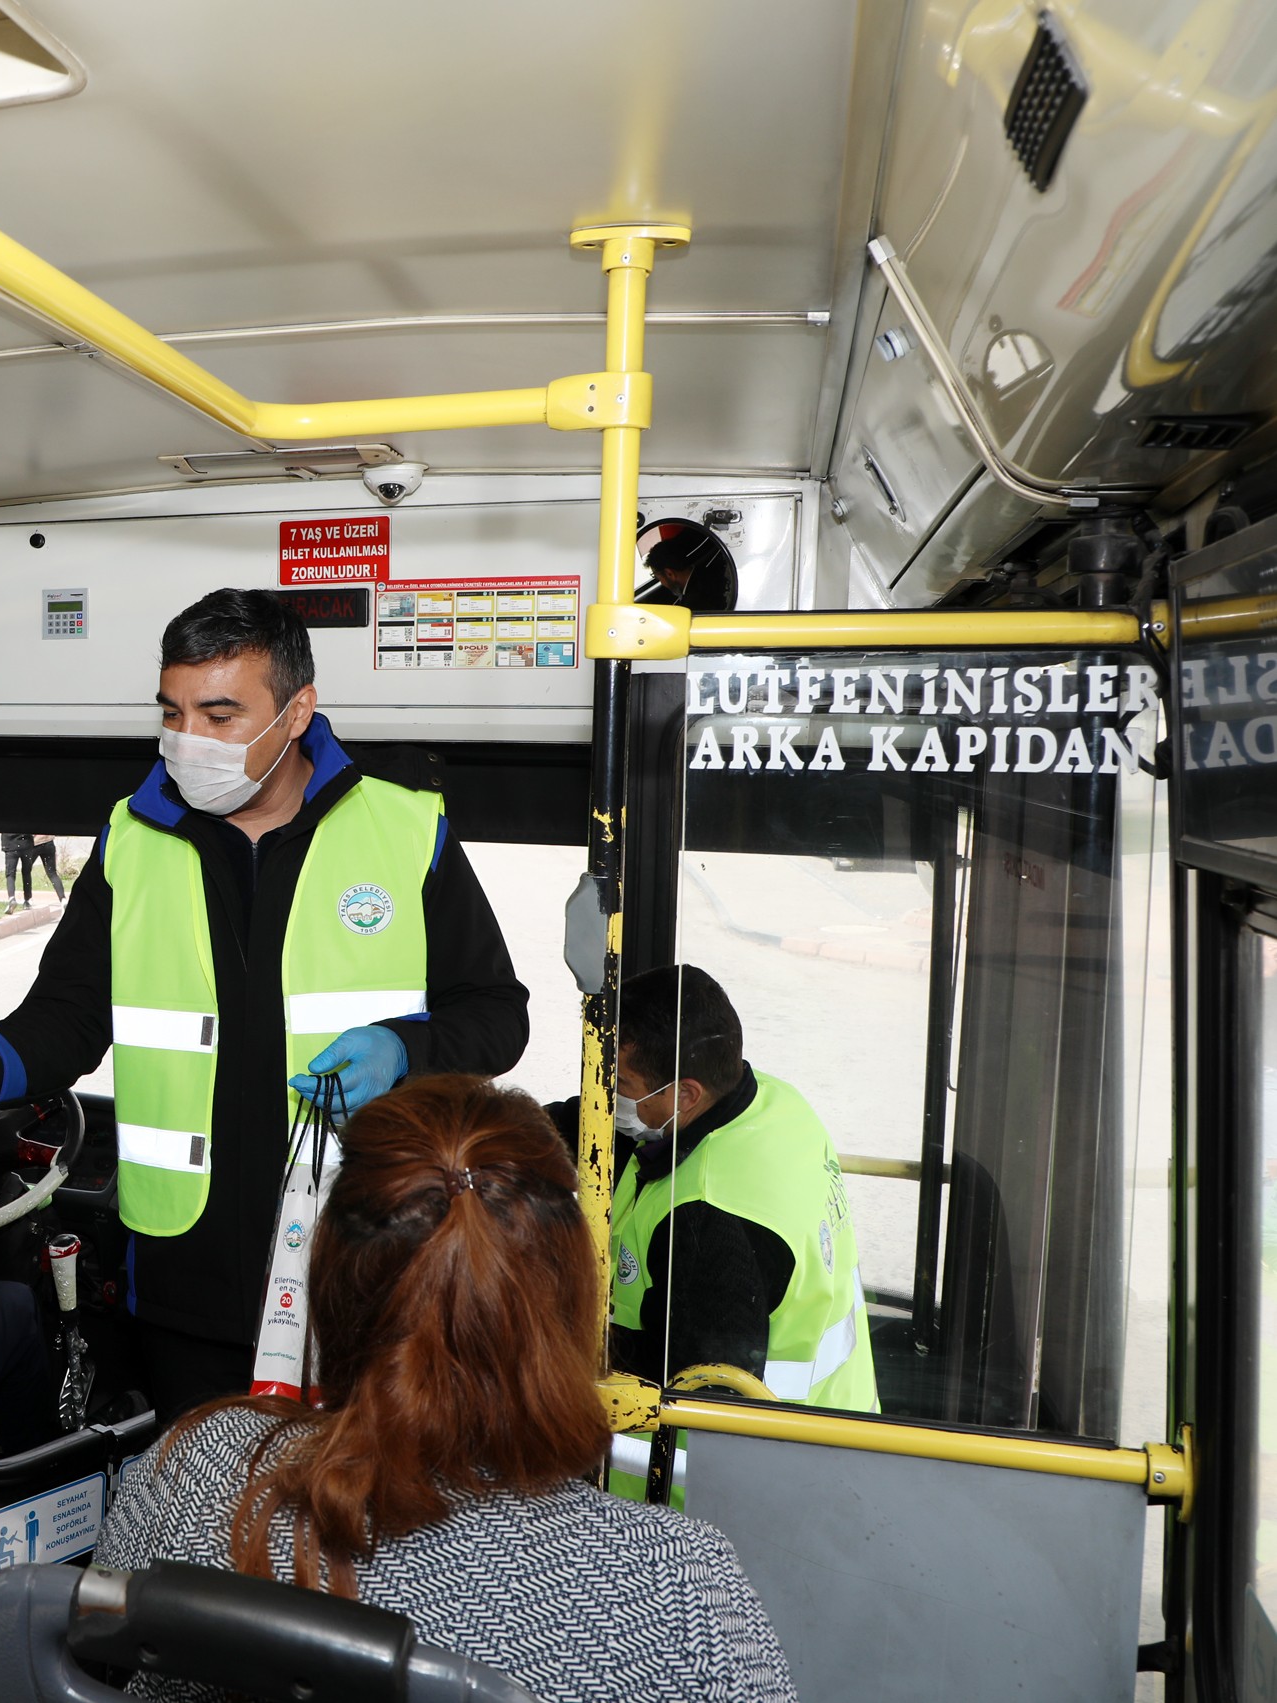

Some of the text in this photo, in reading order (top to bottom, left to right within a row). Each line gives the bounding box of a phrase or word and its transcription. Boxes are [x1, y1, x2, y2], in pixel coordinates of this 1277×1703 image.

[290, 521, 378, 543] 7 YAŞ VE ÜZERİ
[282, 544, 387, 560] BİLET KULLANILMASI
[291, 564, 371, 580] ZORUNLUDUR
[689, 725, 846, 770] ARKA
[866, 726, 1144, 774] KAPIDAN
[340, 886, 392, 917] TALAS BELEDİYESİ
[274, 1276, 304, 1288] Ellerimizi
[289, 1286, 297, 1294] az
[282, 1296, 292, 1305] 20
[274, 1309, 296, 1319] saniye
[267, 1317, 300, 1329] yıkayalım
[57, 1491, 88, 1508] SEYAHAT
[52, 1502, 91, 1522] ESNASINDA
[56, 1515, 88, 1534] ŞOFÖRLE
